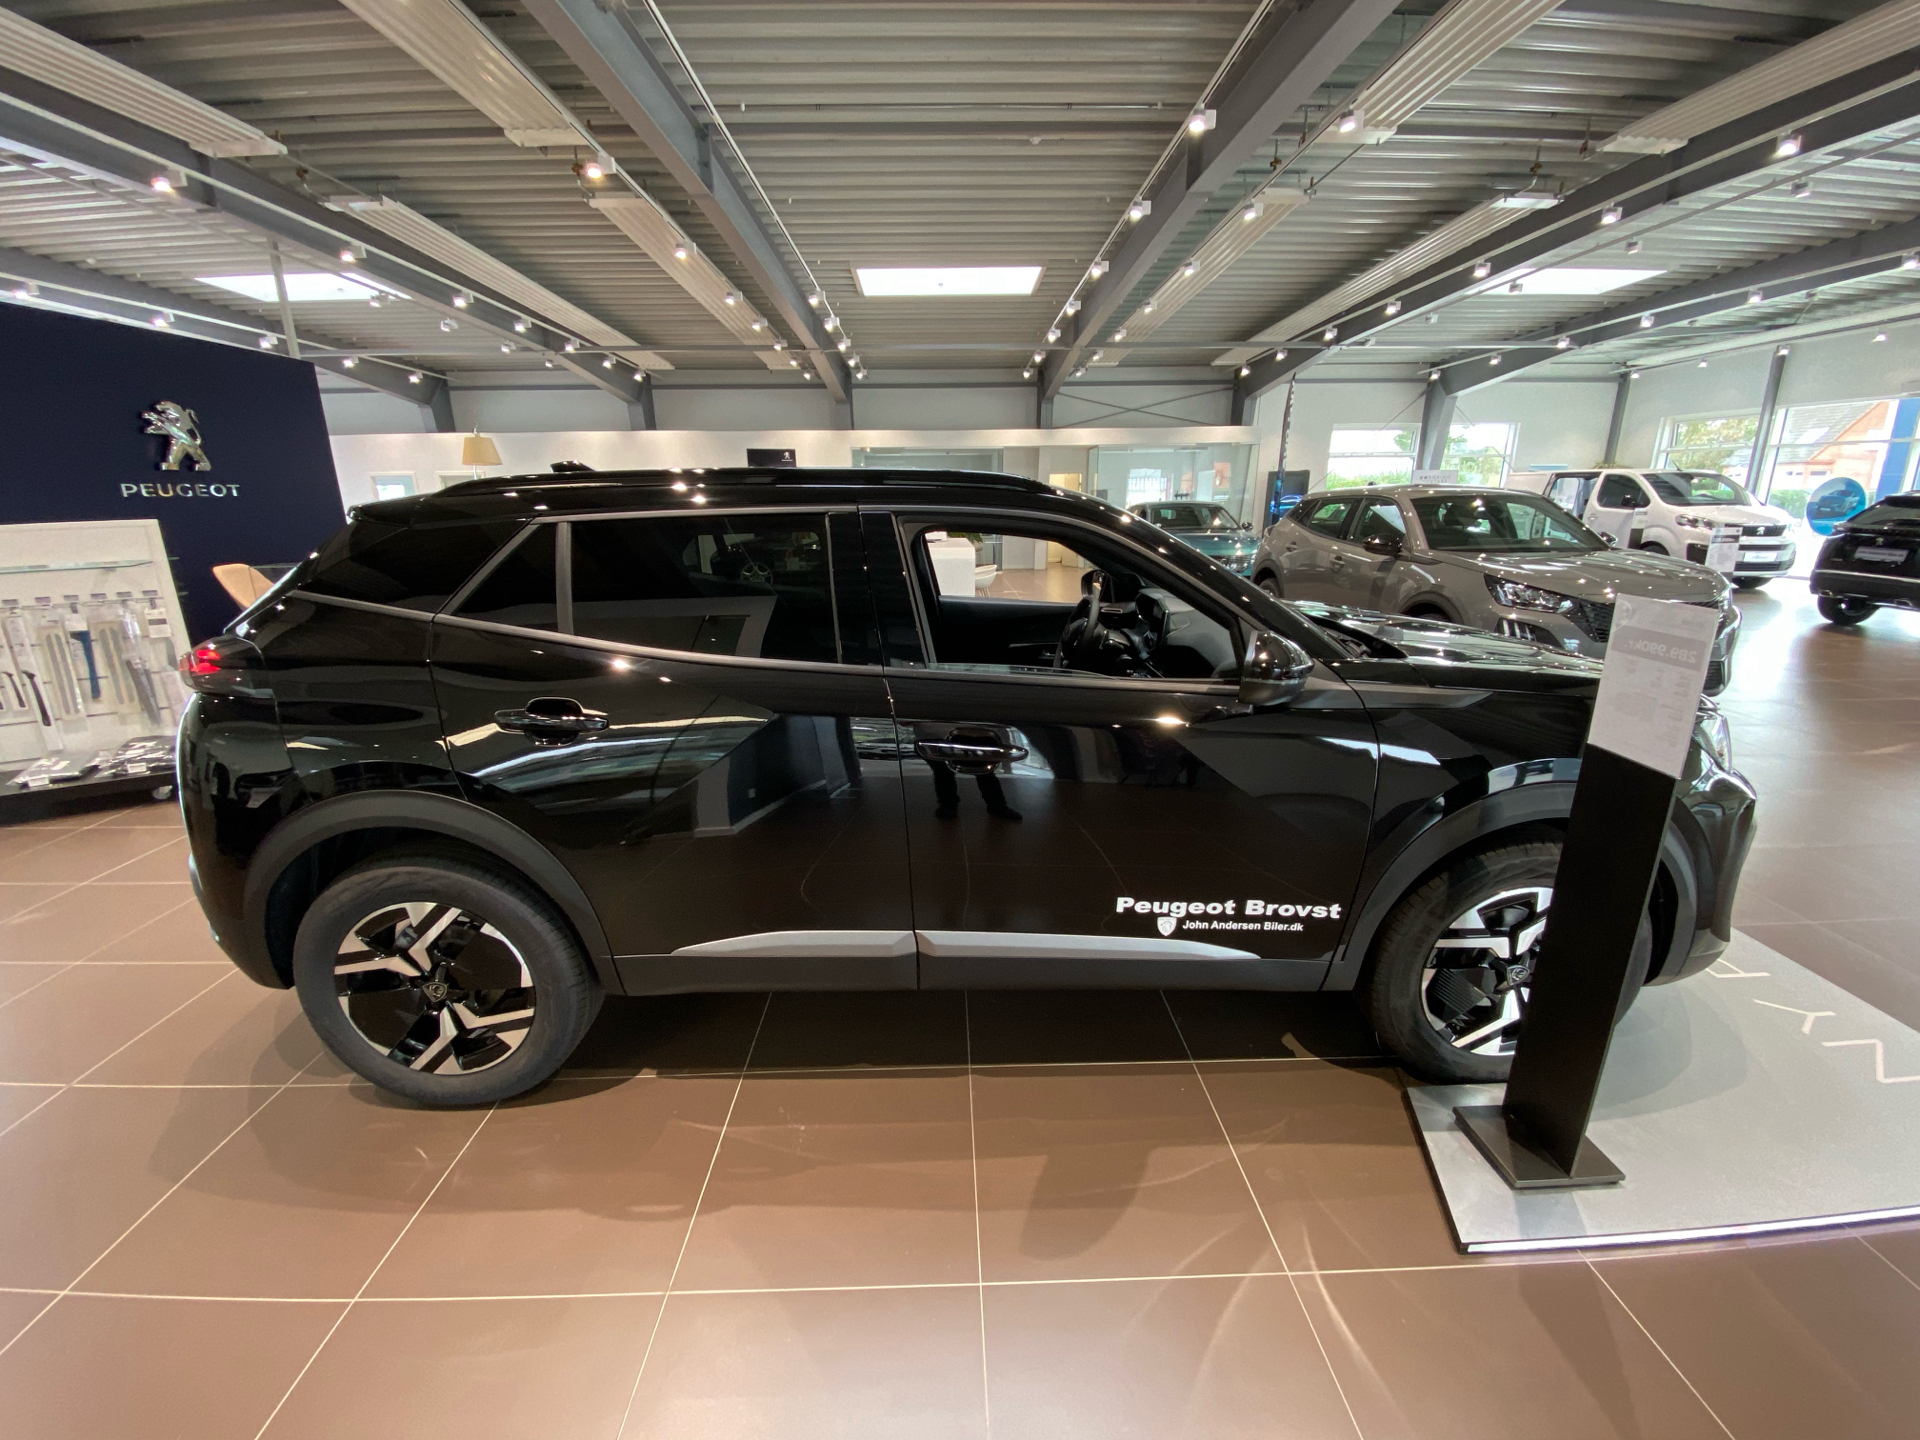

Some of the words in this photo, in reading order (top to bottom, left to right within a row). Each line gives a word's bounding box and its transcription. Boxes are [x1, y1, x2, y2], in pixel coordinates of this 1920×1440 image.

[119, 483, 240, 498] PEUGEOT
[1115, 896, 1236, 918] Peugeot
[1245, 899, 1342, 919] Brovst
[1182, 920, 1209, 930] John
[1210, 920, 1261, 931] Andersen
[1263, 921, 1304, 932] Biler.dk
